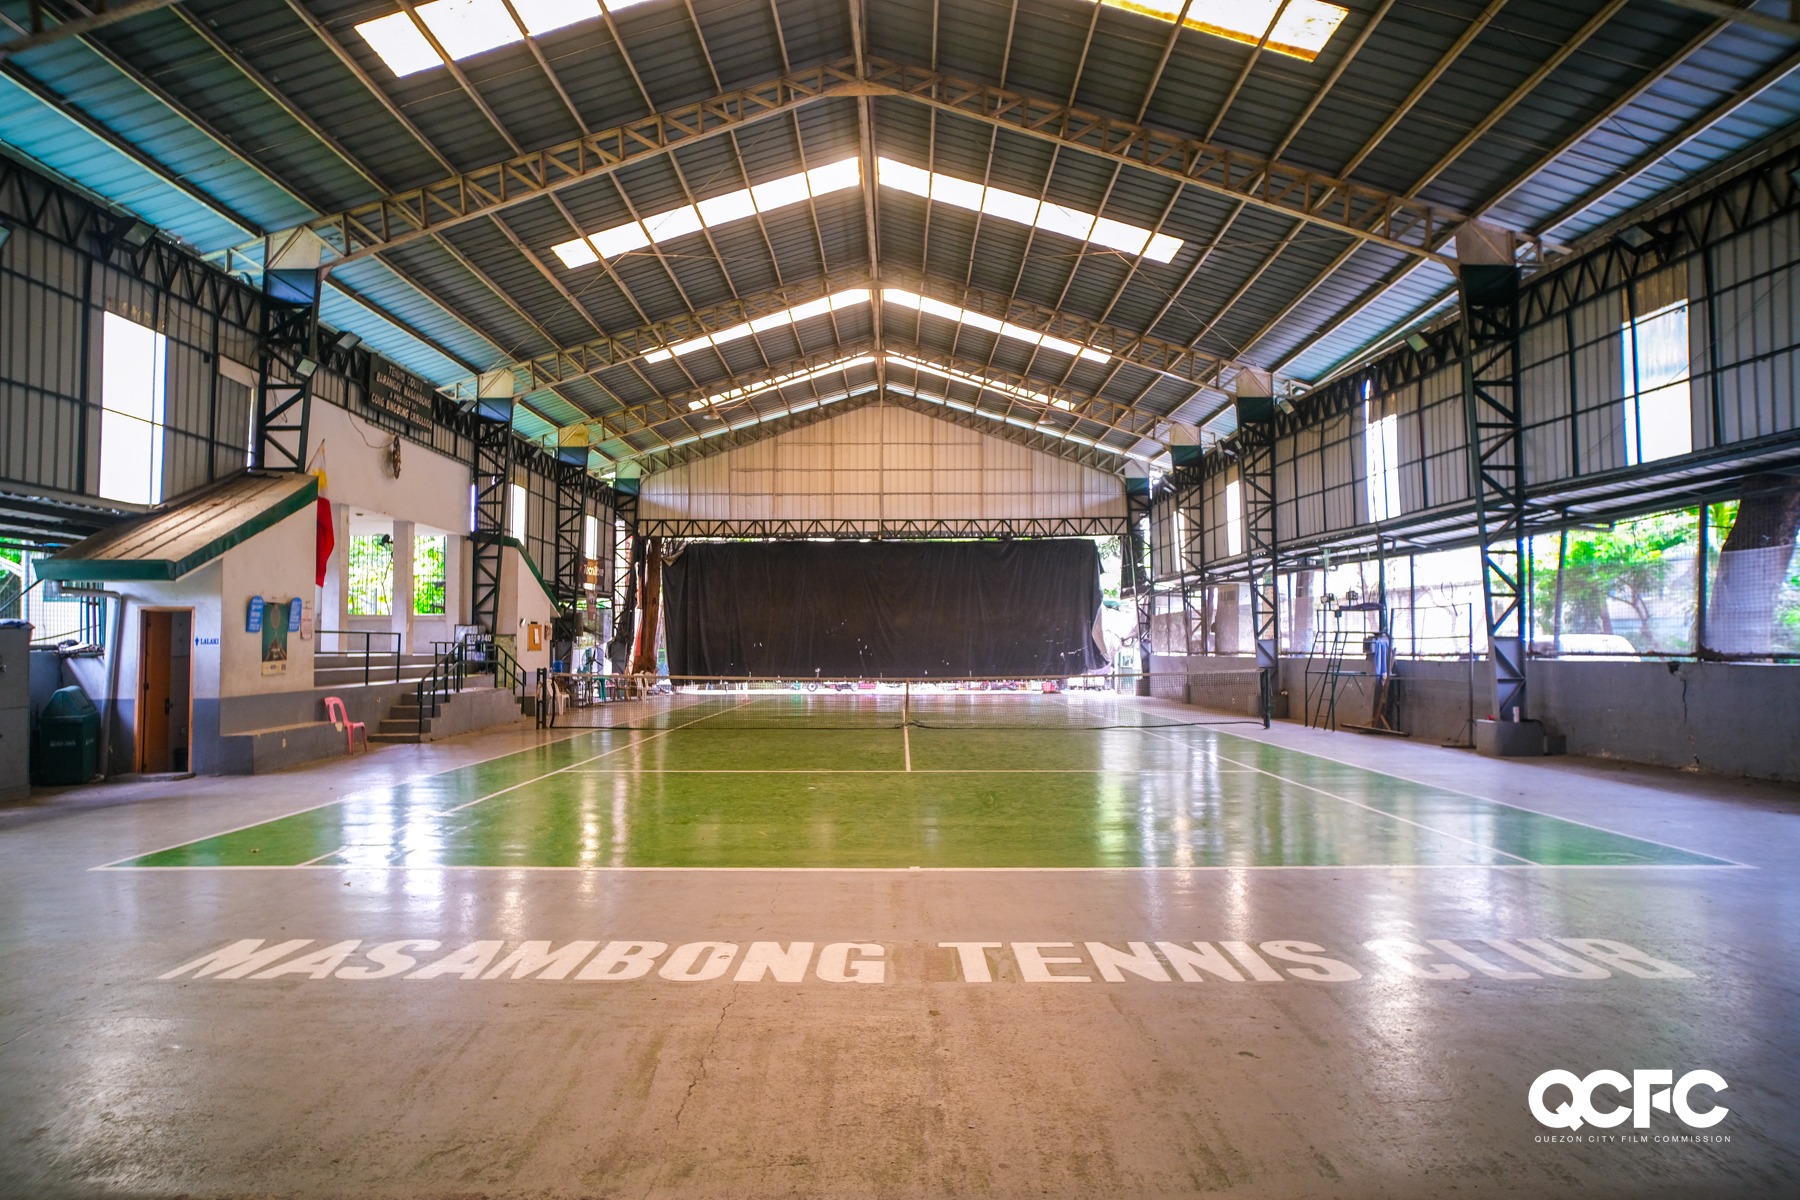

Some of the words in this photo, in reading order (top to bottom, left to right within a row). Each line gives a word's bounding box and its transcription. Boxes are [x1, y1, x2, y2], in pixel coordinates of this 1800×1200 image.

[157, 939, 885, 983] MASAMBONG
[938, 941, 1361, 983] TENNIS
[1362, 939, 1698, 980] CLUB
